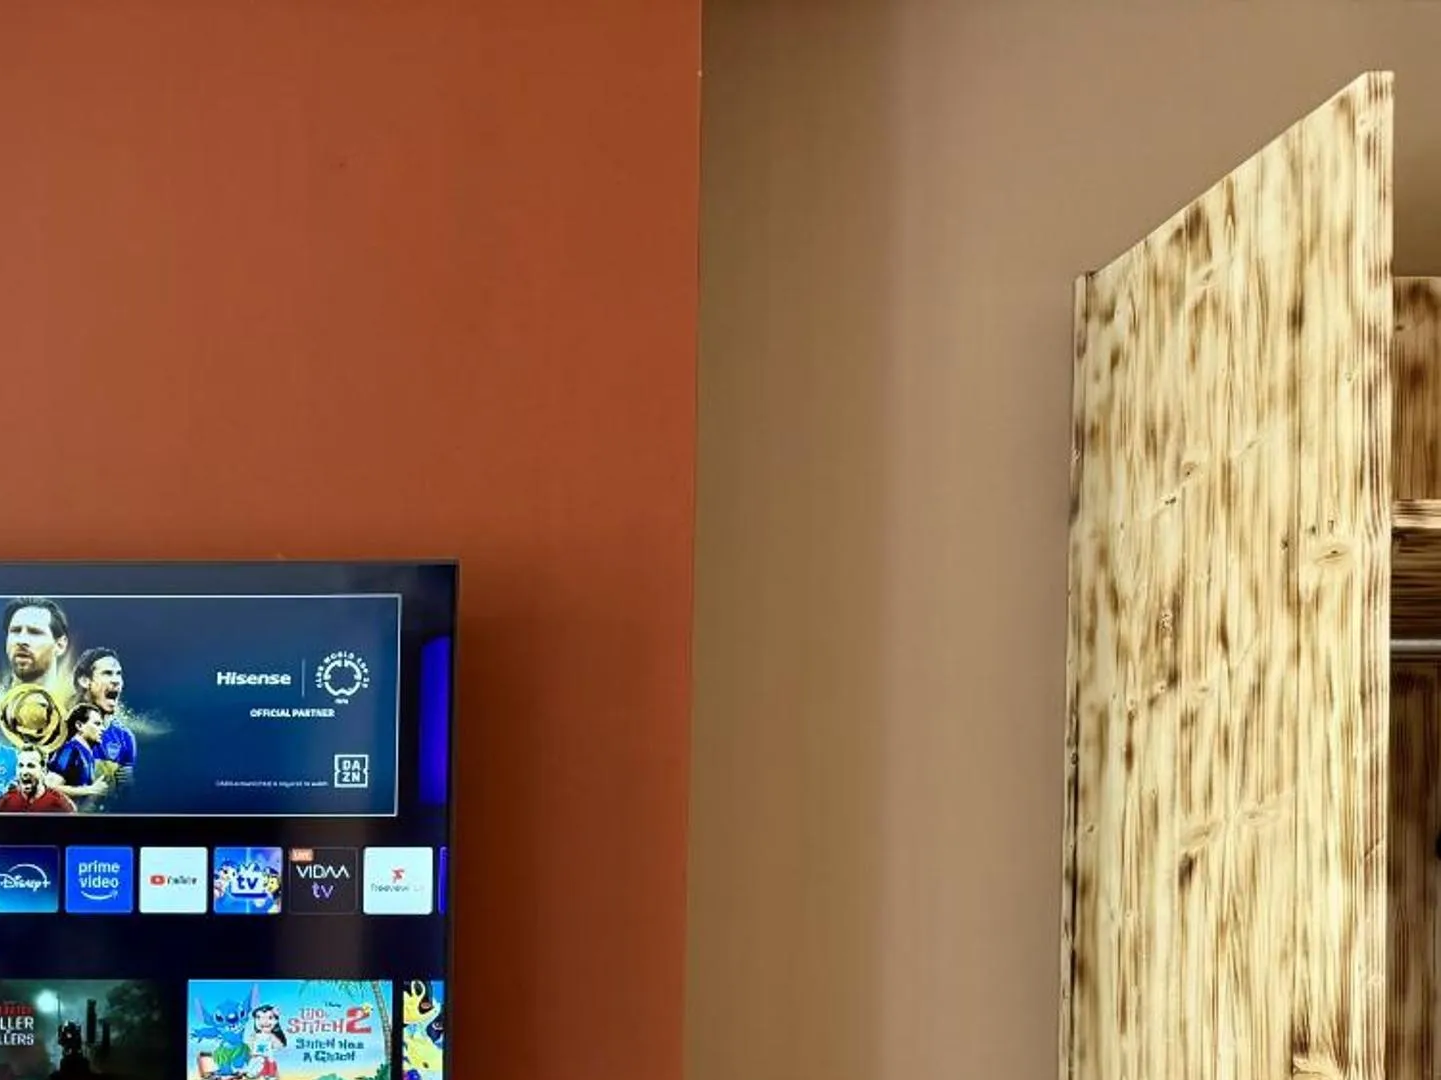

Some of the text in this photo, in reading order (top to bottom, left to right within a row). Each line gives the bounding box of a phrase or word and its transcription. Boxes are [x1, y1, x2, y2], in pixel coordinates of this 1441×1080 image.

[216, 671, 291, 685] Hisense
[249, 708, 336, 718] OFFICIAL PARTNER
[78, 860, 120, 875] prime
[295, 864, 350, 879] VIDAA
[79, 875, 119, 888] video
[312, 882, 334, 898] tv
[346, 1007, 371, 1033] 2
